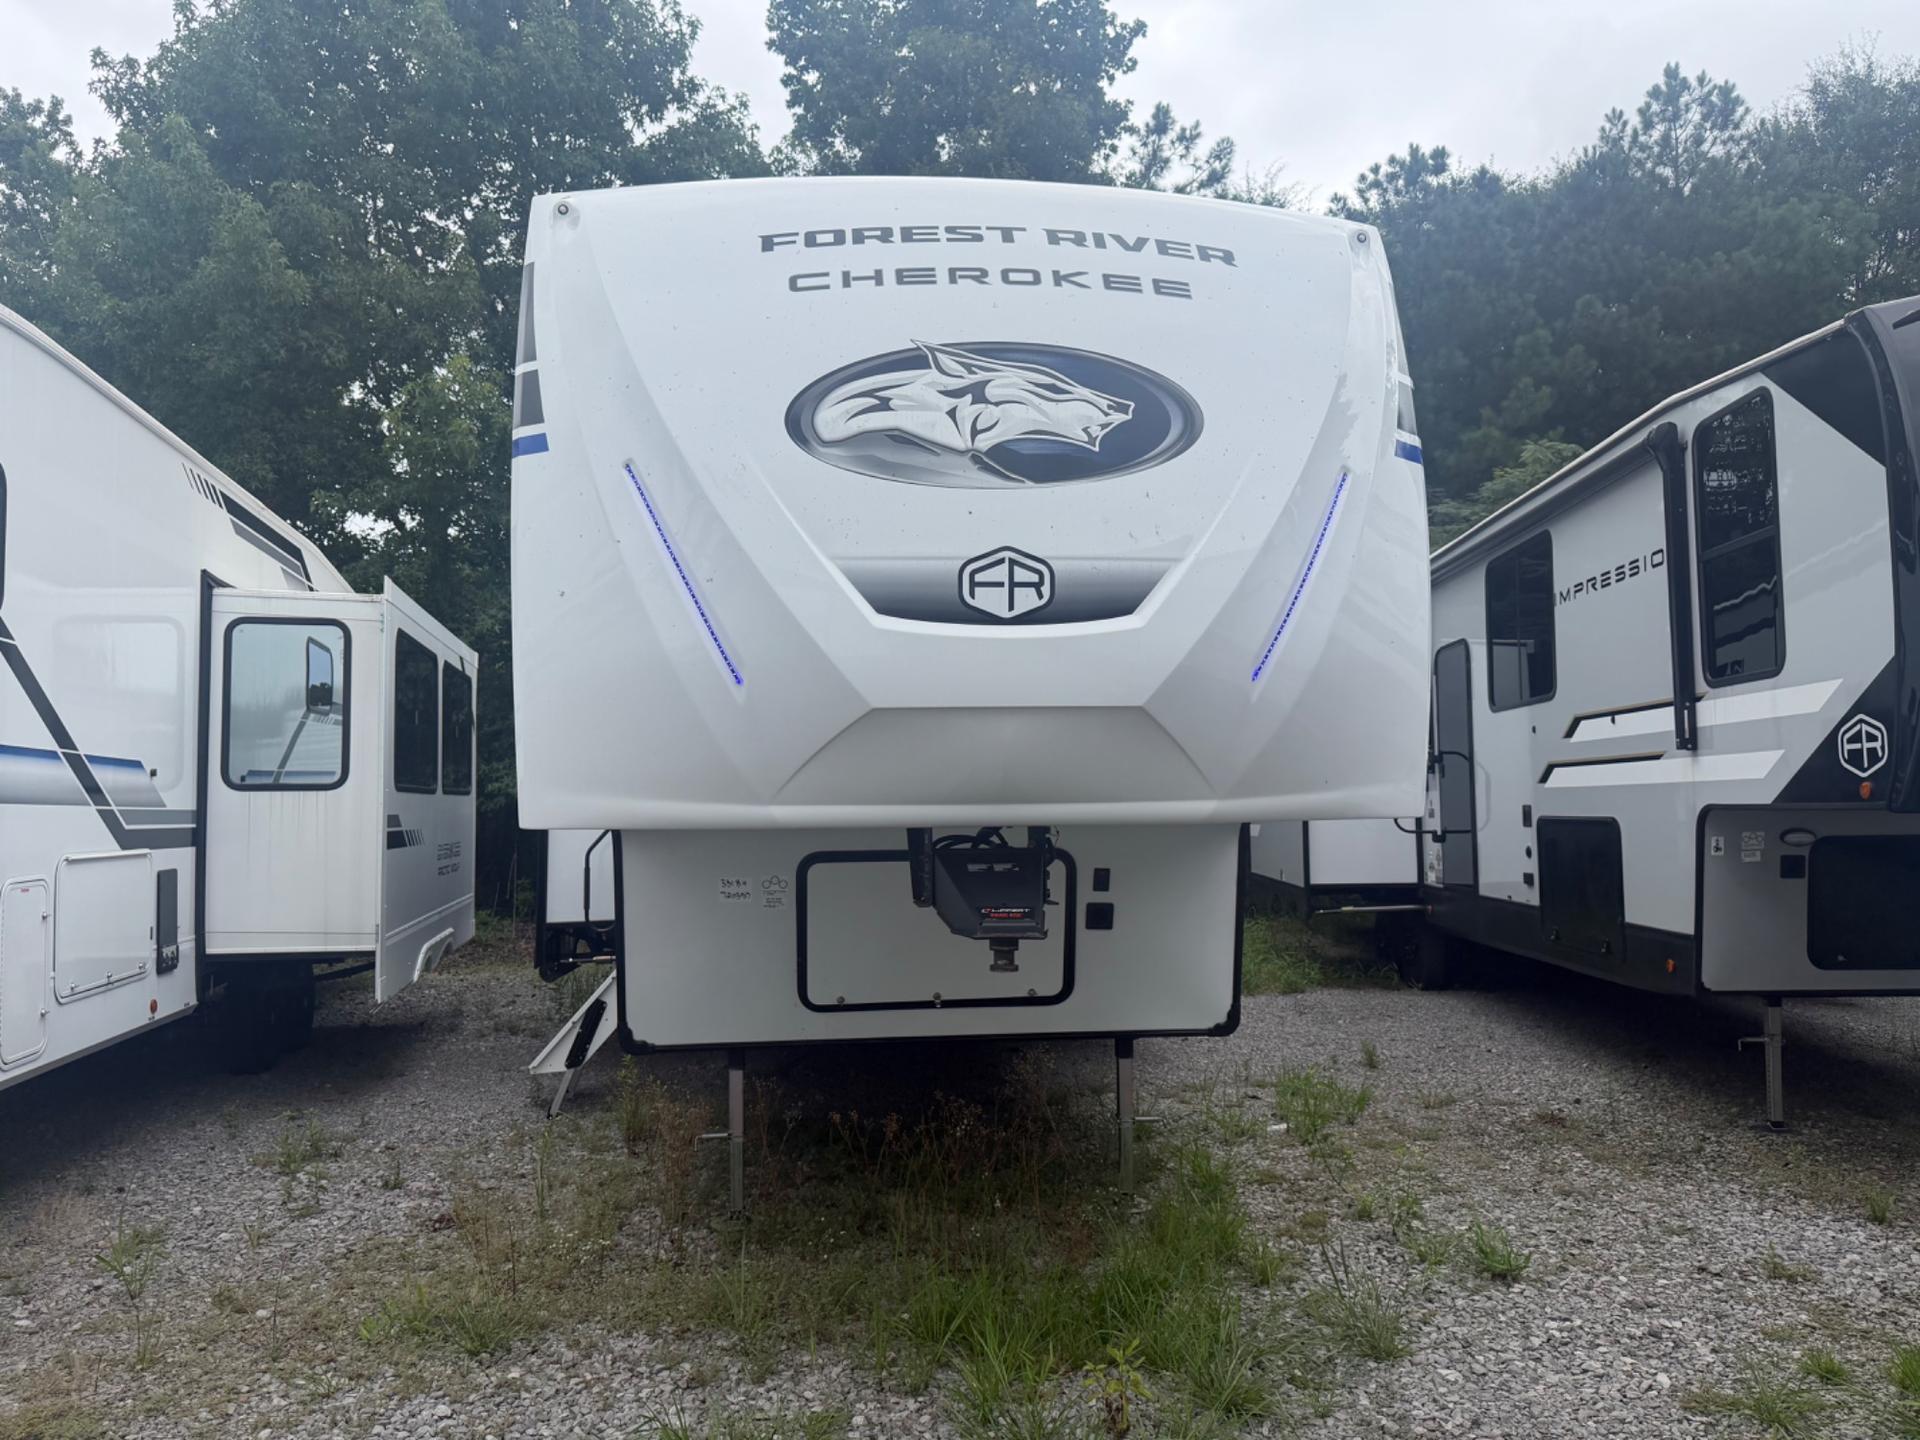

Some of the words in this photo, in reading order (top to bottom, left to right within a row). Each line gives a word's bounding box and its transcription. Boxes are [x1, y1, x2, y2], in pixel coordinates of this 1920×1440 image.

[758, 225, 1027, 253] FOREST
[1041, 227, 1239, 267] RIVER
[788, 266, 1193, 300] CHEROKEE
